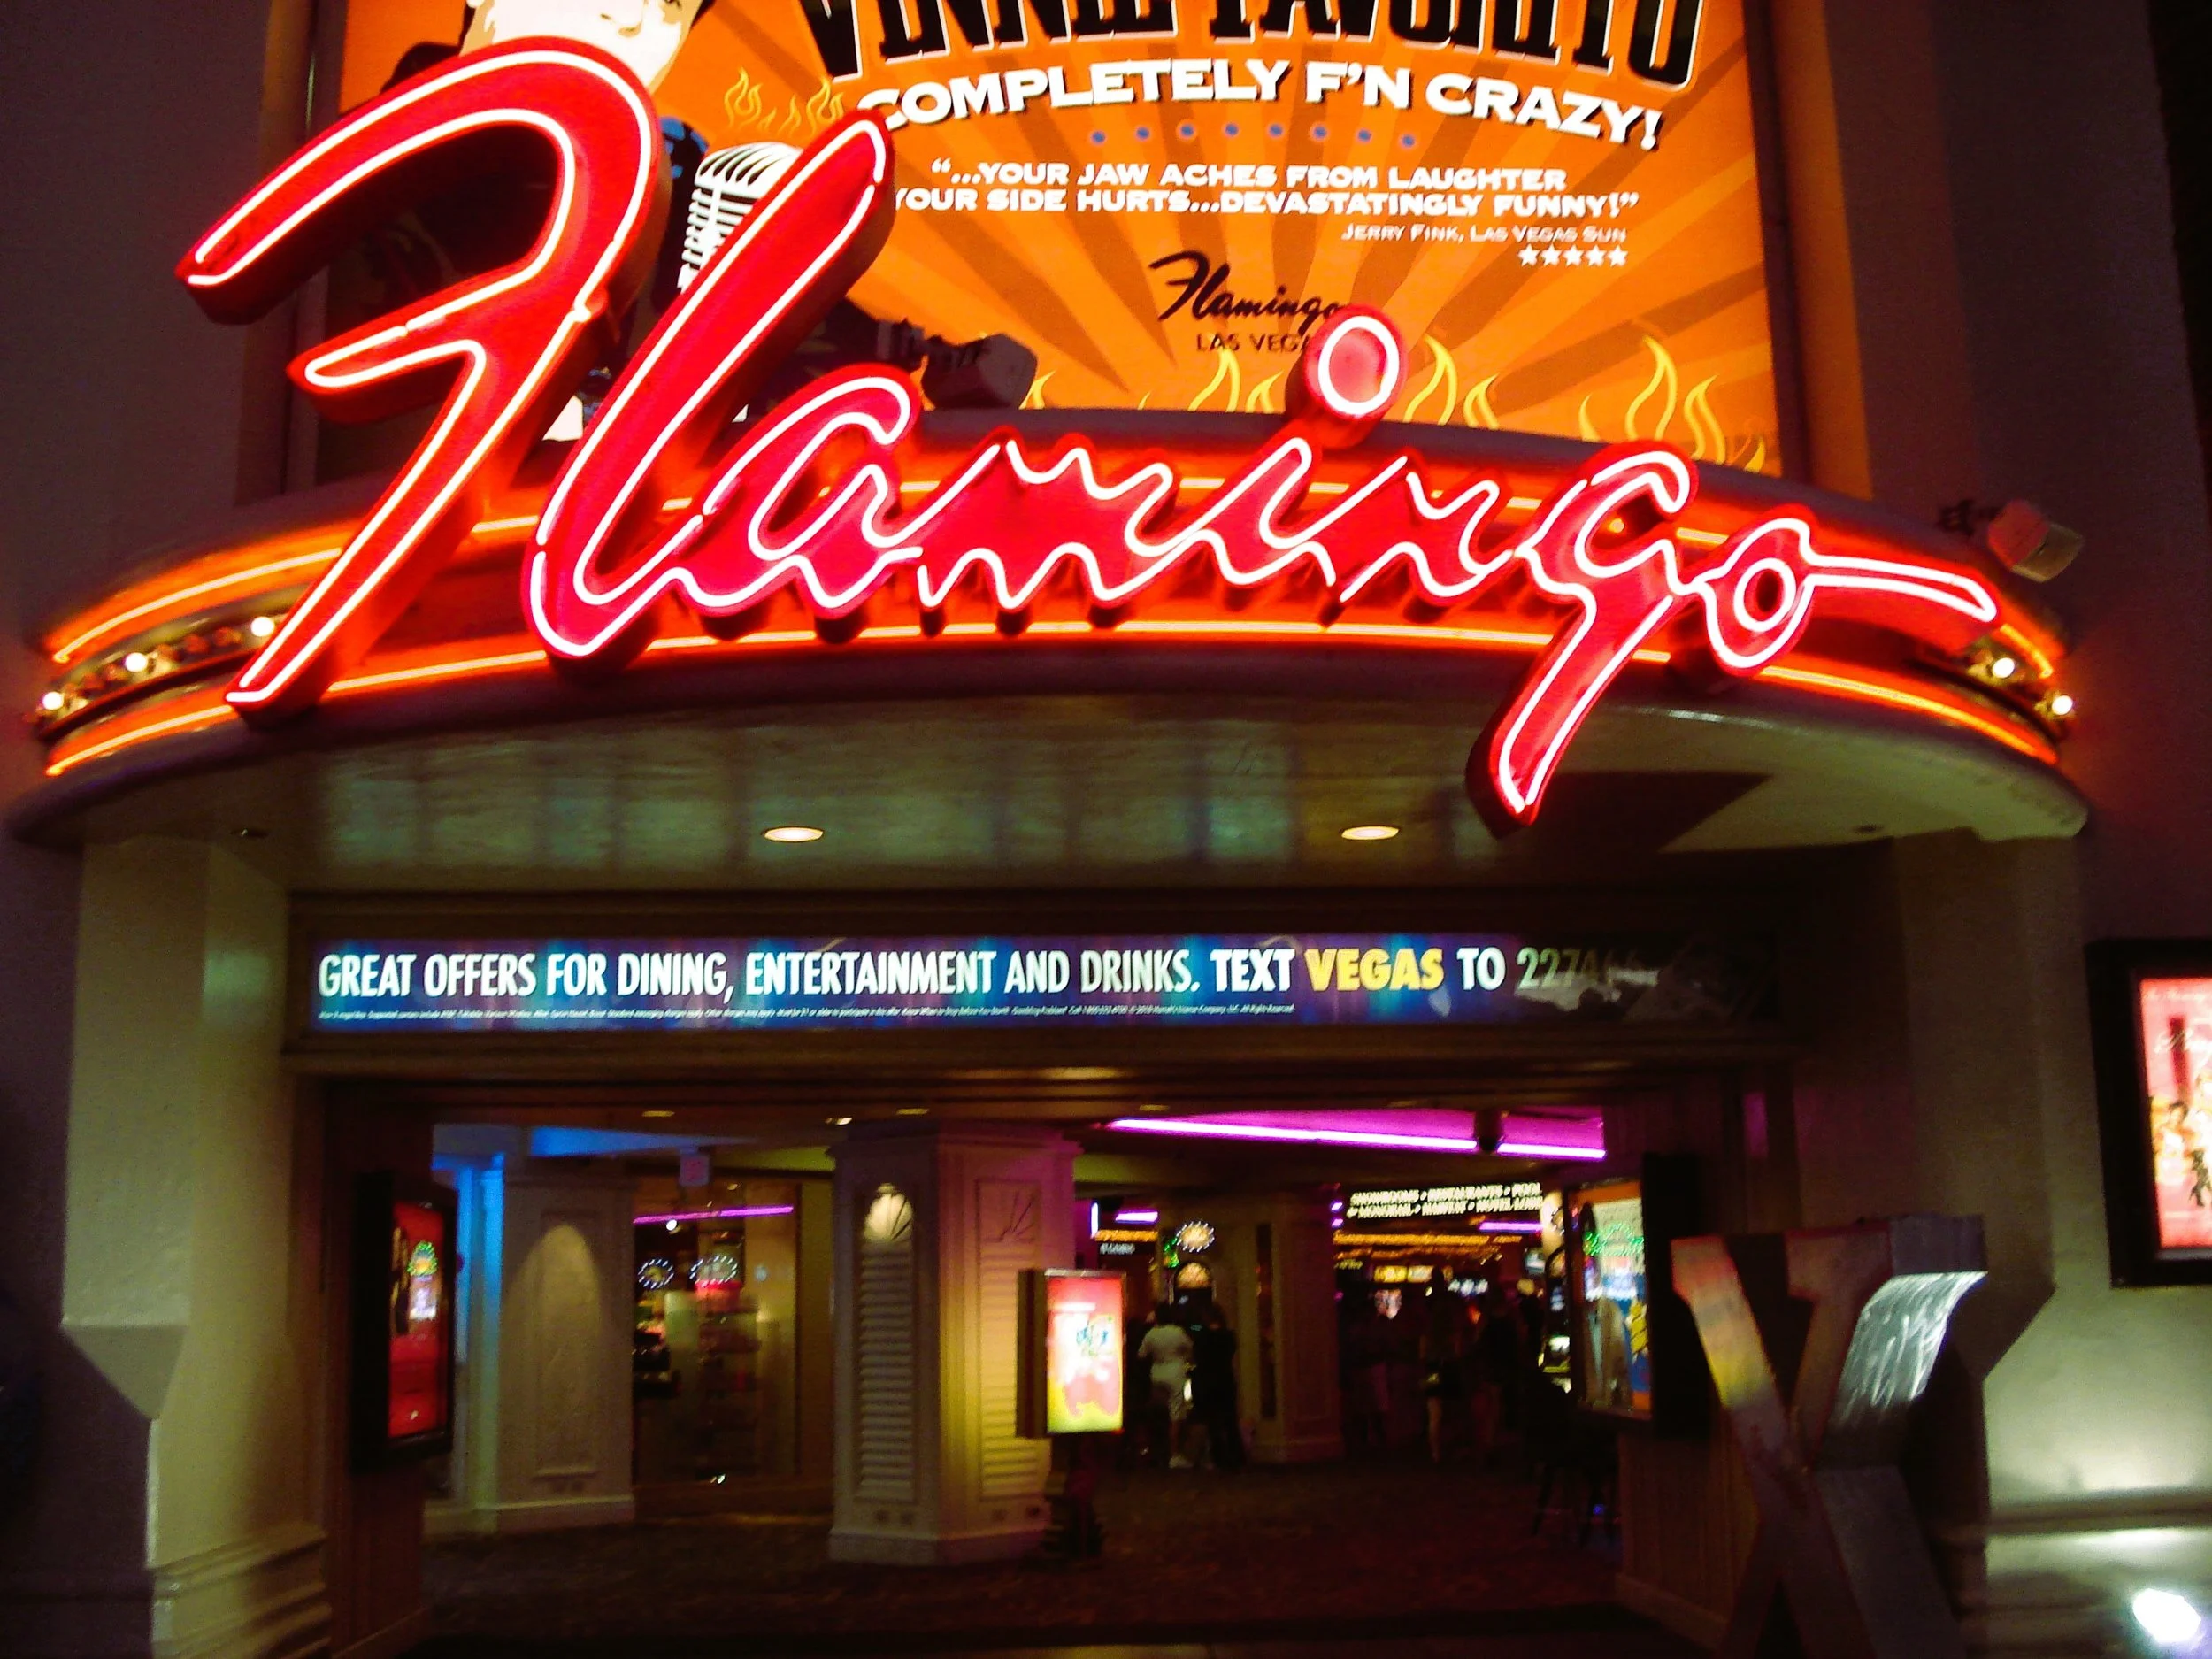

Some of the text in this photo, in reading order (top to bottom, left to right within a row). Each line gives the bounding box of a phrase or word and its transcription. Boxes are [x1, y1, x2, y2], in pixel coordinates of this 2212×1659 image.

[856, 58, 1663, 150] COMPLETELY F'N CRAZY!
[987, 189, 1067, 211] SIDE
[1077, 163, 1150, 186] JAW
[1159, 164, 1278, 188] ACHES
[1286, 165, 1378, 189] FROM
[1387, 167, 1567, 192] LAUGHTER
[1148, 250, 1344, 337] Flamingo
[1197, 333, 1310, 352] LAS VEG
[176, 37, 2001, 823] Flamingo
[319, 954, 417, 998] GREAT
[424, 953, 537, 998] OFFERS
[546, 952, 608, 997] FOR
[617, 951, 735, 1004] DINING,
[745, 950, 997, 995] ENTERTAINMENT
[1003, 950, 1070, 994] AND
[1080, 949, 1201, 994] DRINKS.
[1209, 949, 1296, 992] TEXT
[1304, 948, 1444, 992] VEGAS
[1456, 947, 1506, 991] TO
